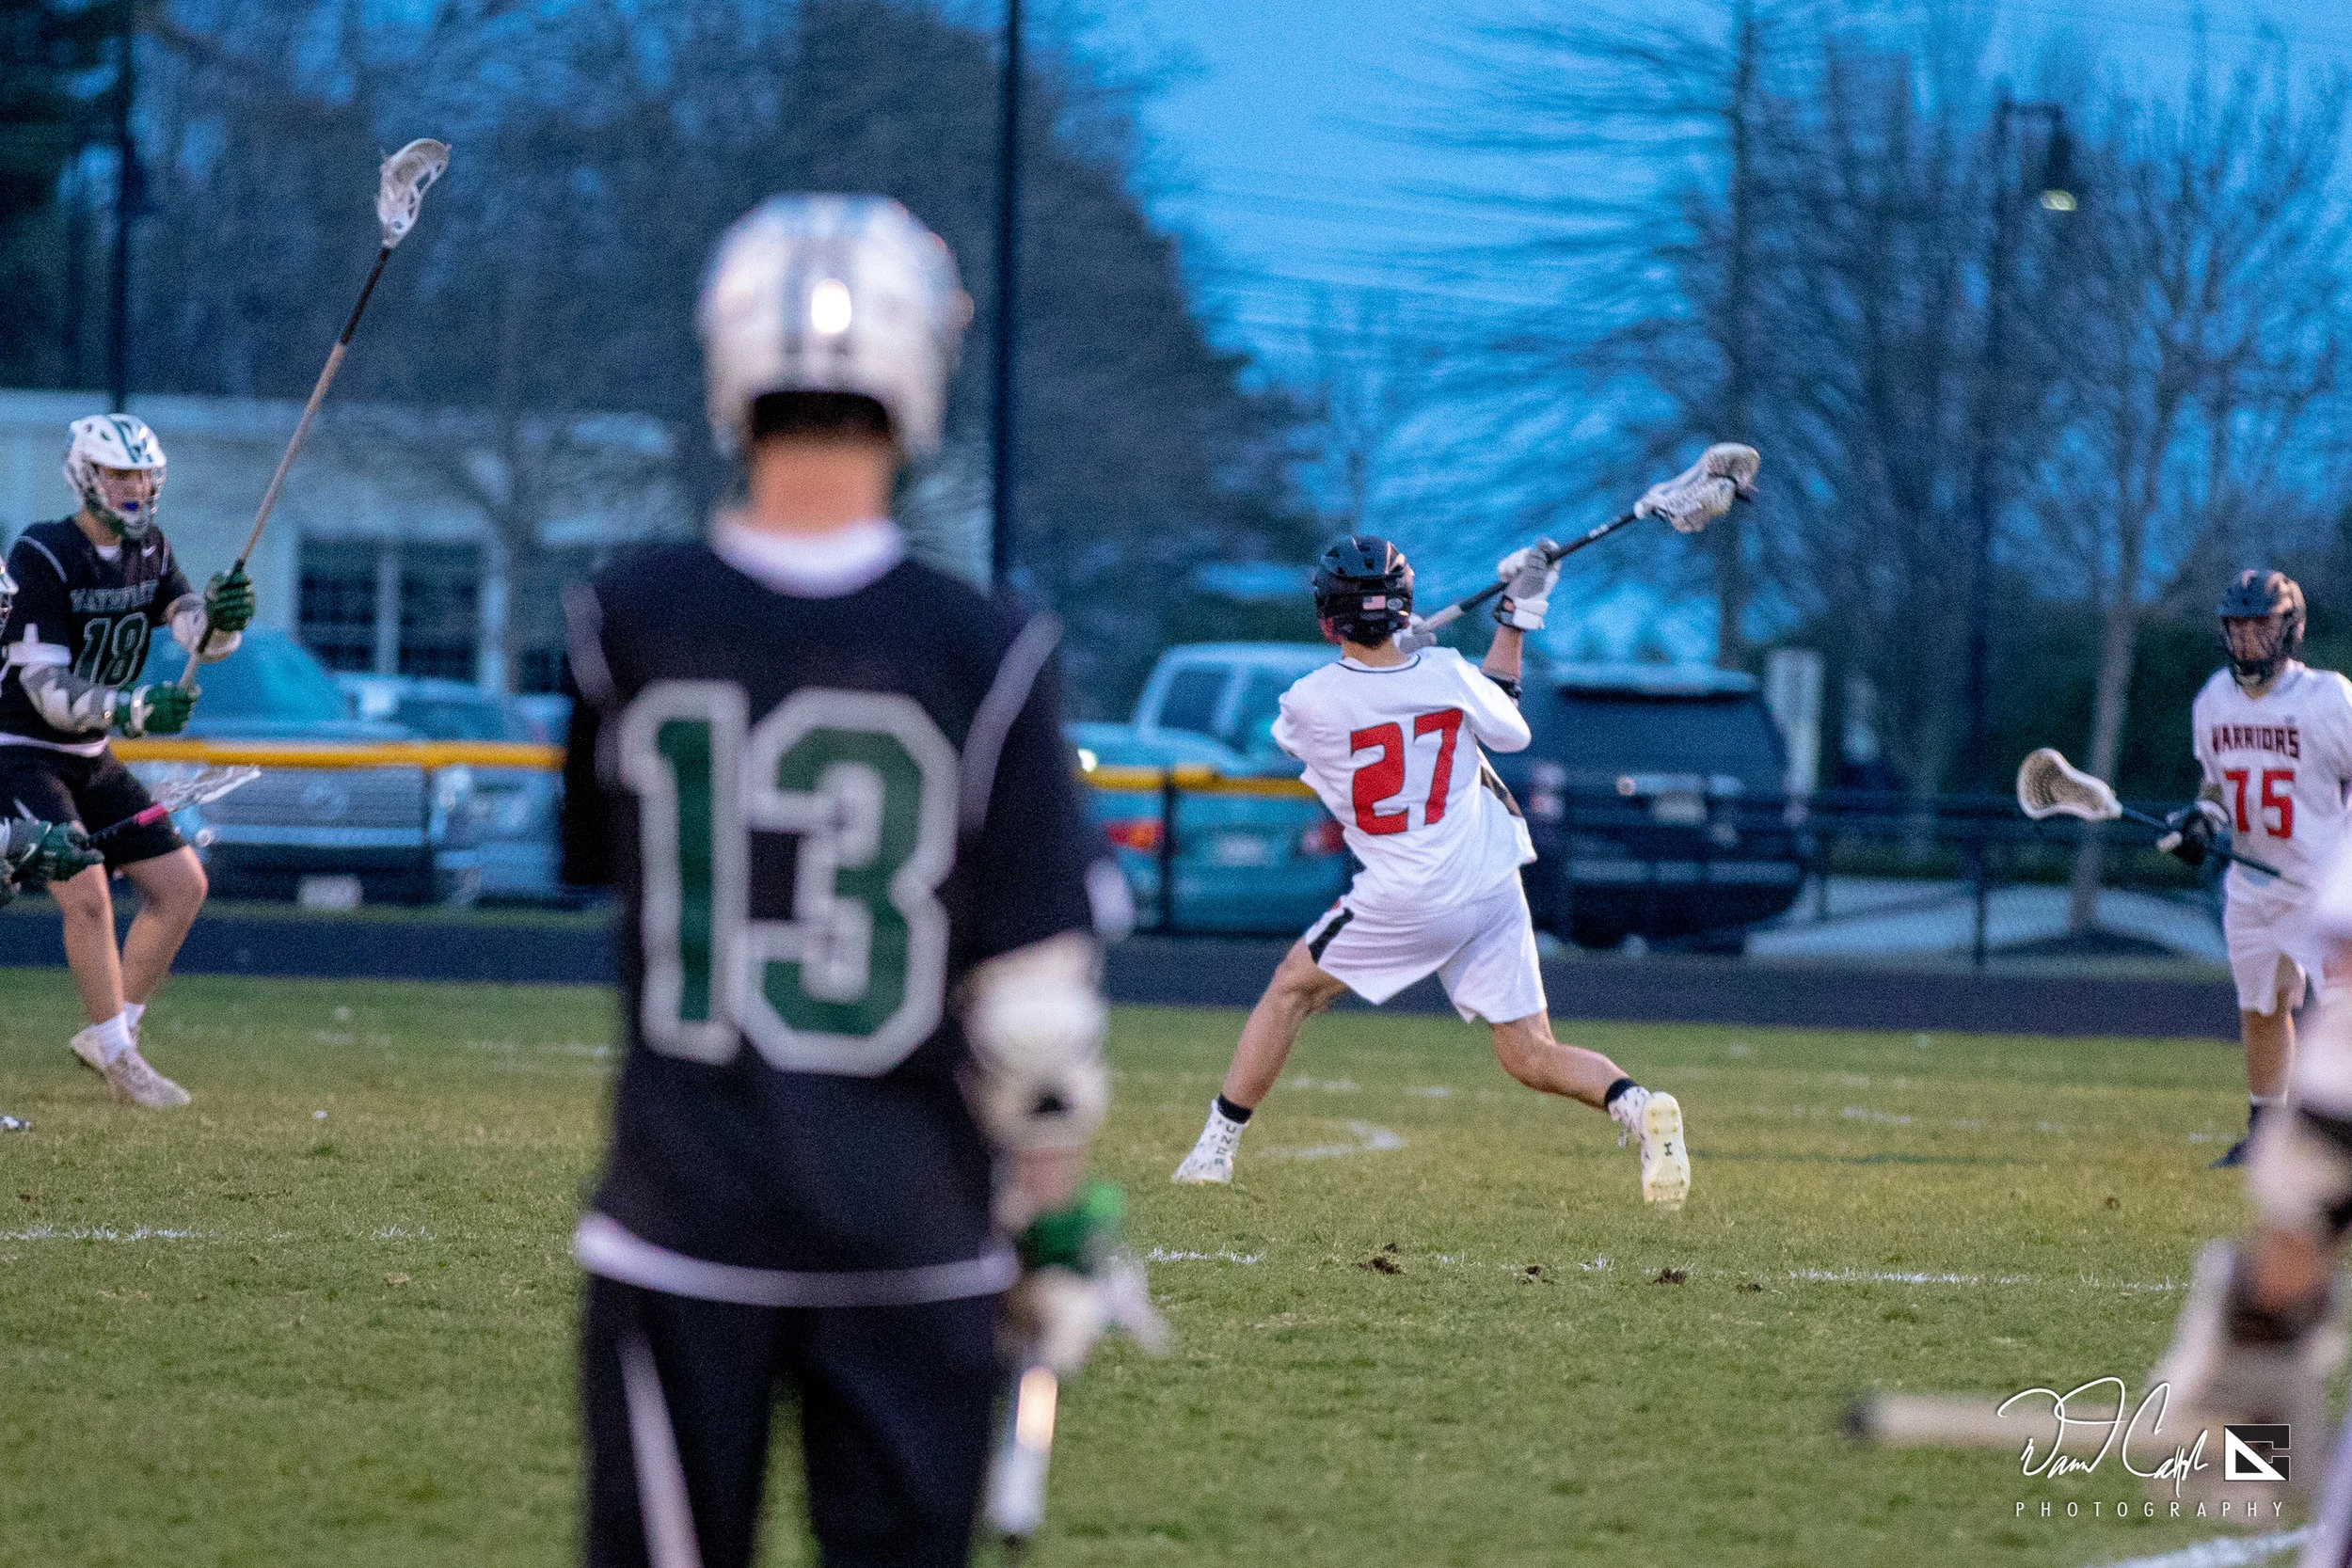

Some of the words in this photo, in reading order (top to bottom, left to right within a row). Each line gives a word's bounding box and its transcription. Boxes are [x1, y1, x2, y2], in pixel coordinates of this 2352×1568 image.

[74, 611, 148, 689] 18
[1350, 708, 1463, 835] 27
[2224, 768, 2295, 839] 75
[617, 678, 961, 1078] 13
